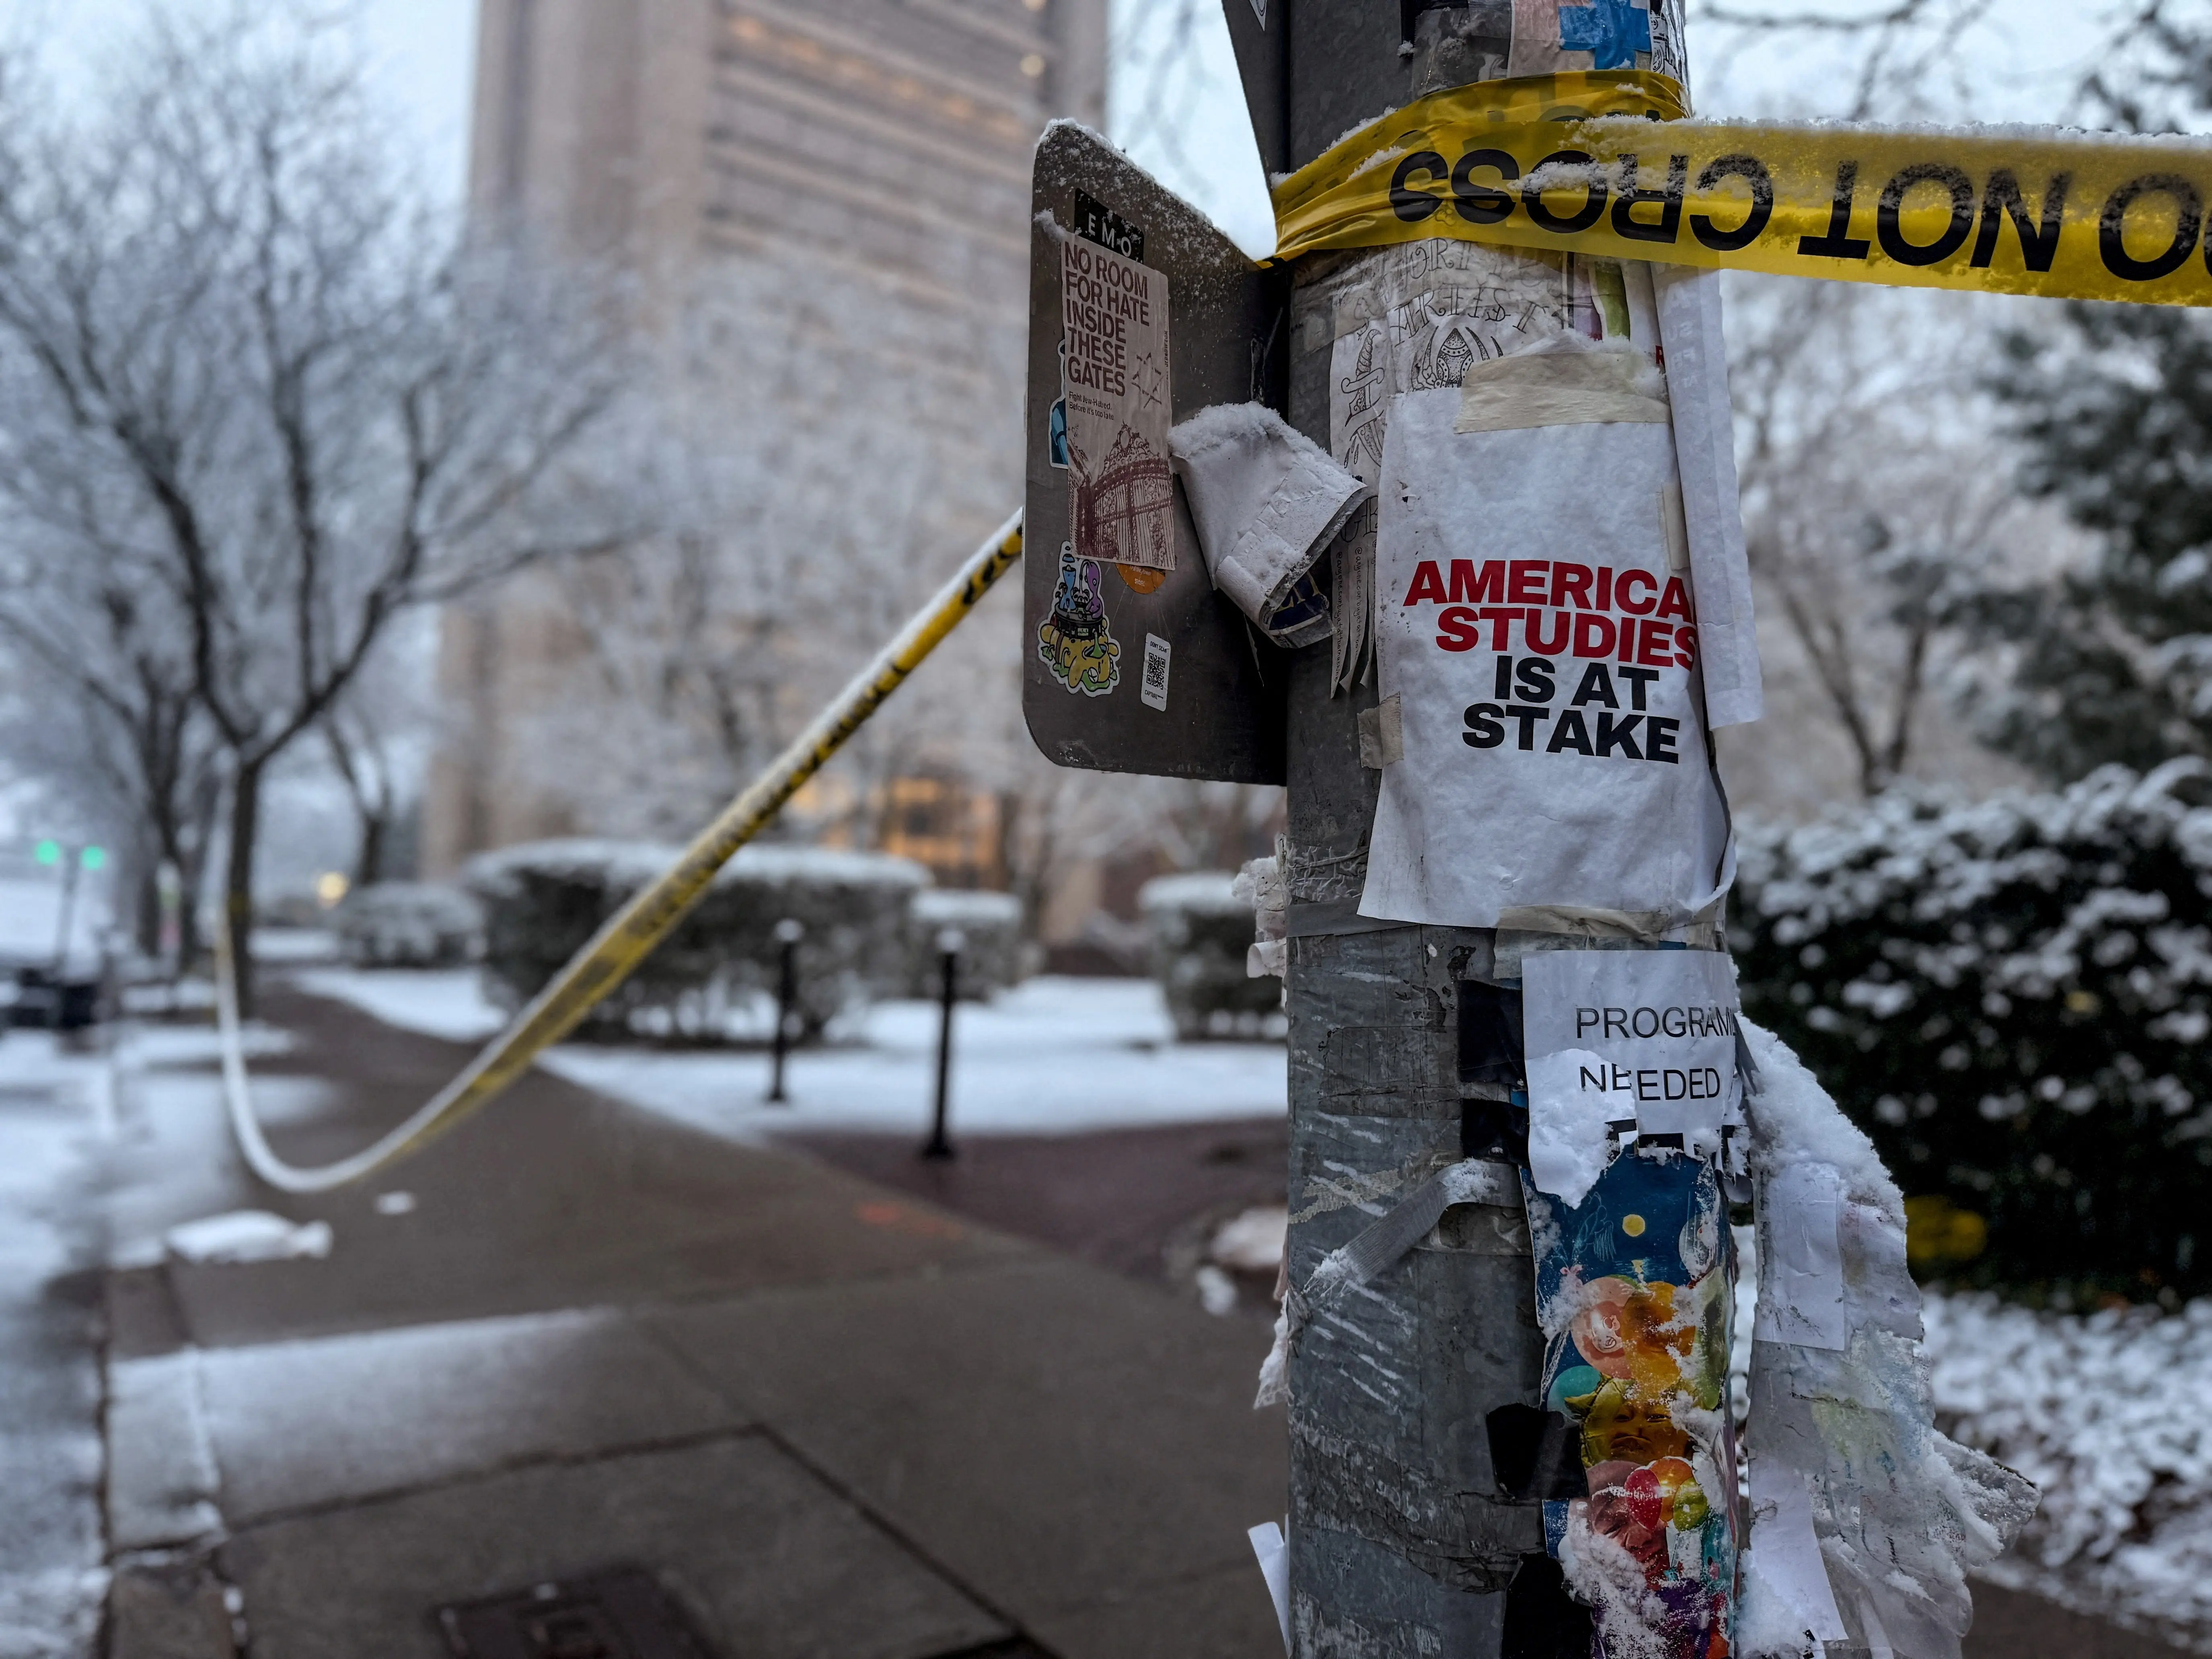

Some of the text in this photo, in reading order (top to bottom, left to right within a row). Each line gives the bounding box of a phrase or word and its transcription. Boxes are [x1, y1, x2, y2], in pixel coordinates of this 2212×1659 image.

[1088, 212, 1131, 257] EMO
[1797, 160, 2073, 272] NOT
[2099, 173, 2212, 282] O
[1065, 242, 1148, 300] NO ROOM
[1065, 272, 1149, 327] FOR HATE
[1066, 299, 1126, 343] INSIDE
[1067, 327, 1126, 370] THESE
[1068, 356, 1125, 397] GATES
[1069, 391, 1082, 402] Fight
[1069, 402, 1086, 413] Before
[1095, 409, 1103, 417] too
[1104, 412, 1114, 420] late
[1403, 559, 1694, 625] AMERICA
[1436, 606, 1697, 672] STUDIES
[1495, 655, 1659, 711] IS AT
[1462, 703, 1680, 764] STAKE
[1579, 1063, 1721, 1101] NEEDED
